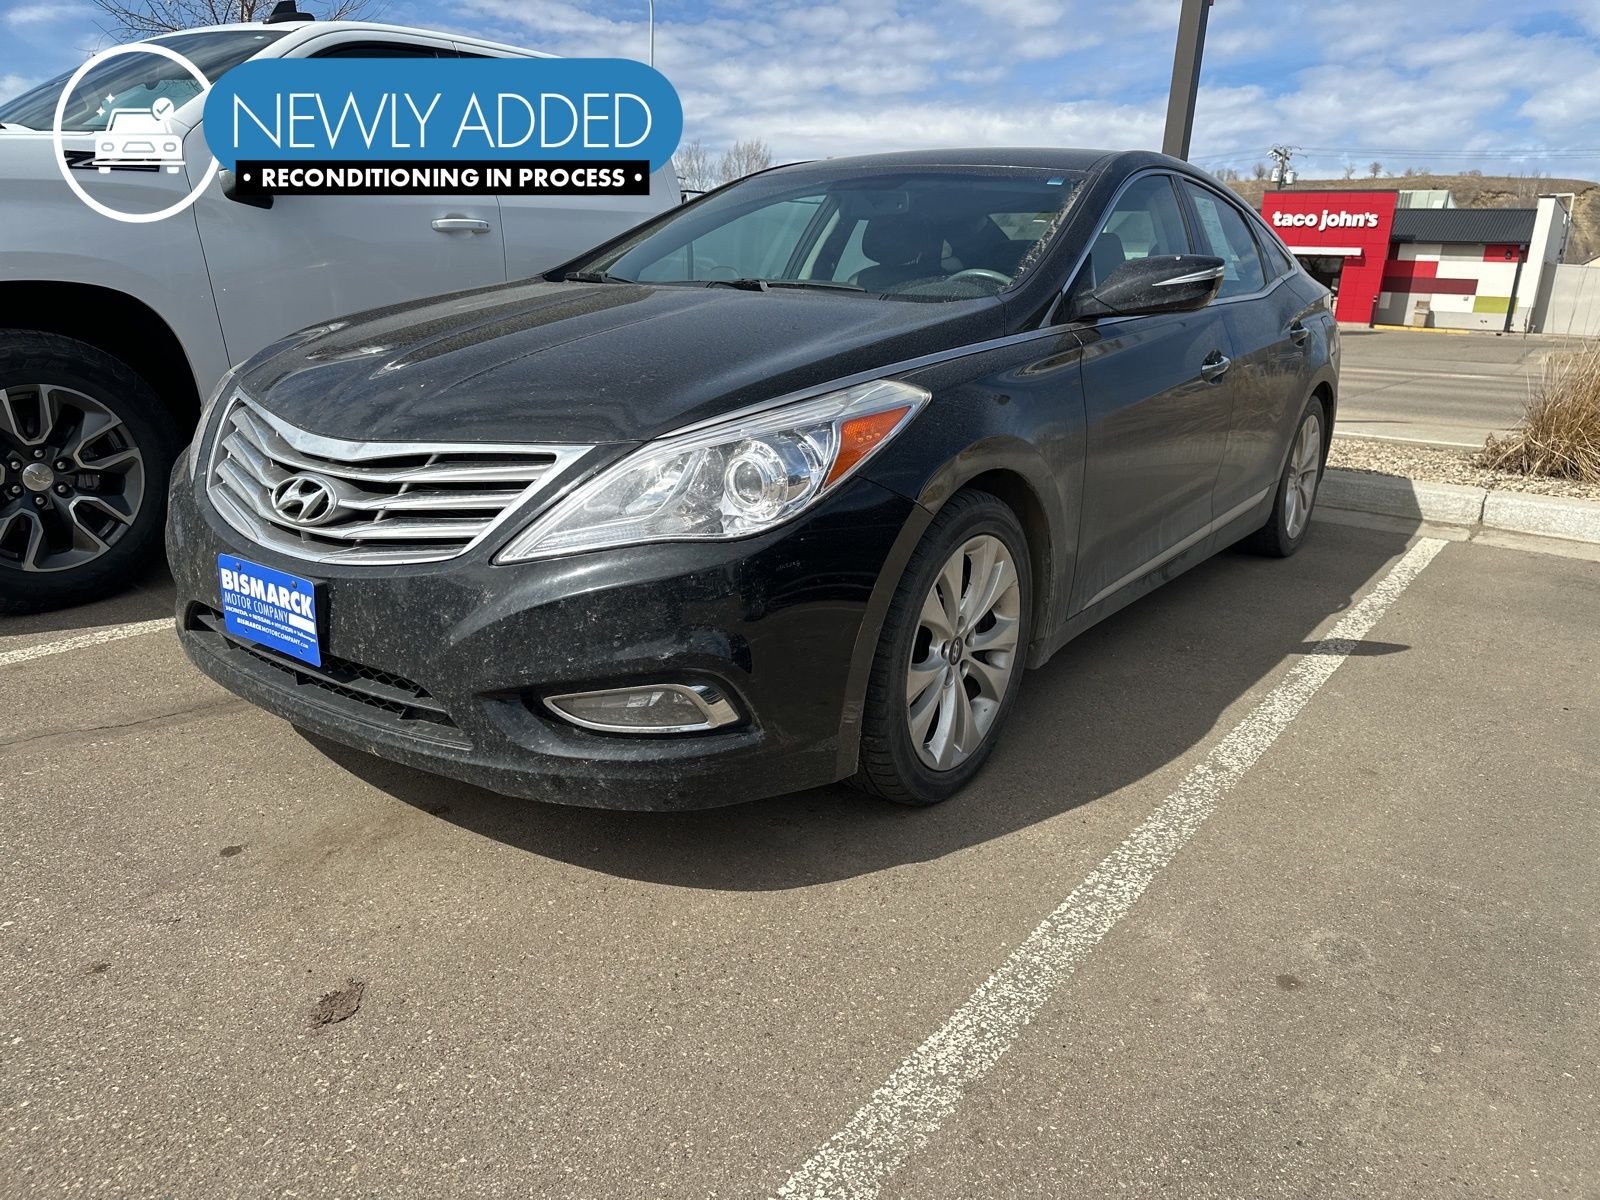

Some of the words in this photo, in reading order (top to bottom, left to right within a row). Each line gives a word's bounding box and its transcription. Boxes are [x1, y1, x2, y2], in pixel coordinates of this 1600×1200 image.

[1272, 210, 1318, 227] taco
[1318, 209, 1379, 231] john's
[220, 567, 314, 620] BISMARCK
[224, 591, 252, 611] MOTOR
[253, 600, 290, 624] COMPANY
[225, 605, 249, 617] HONDA
[252, 613, 271, 626] NISSAN
